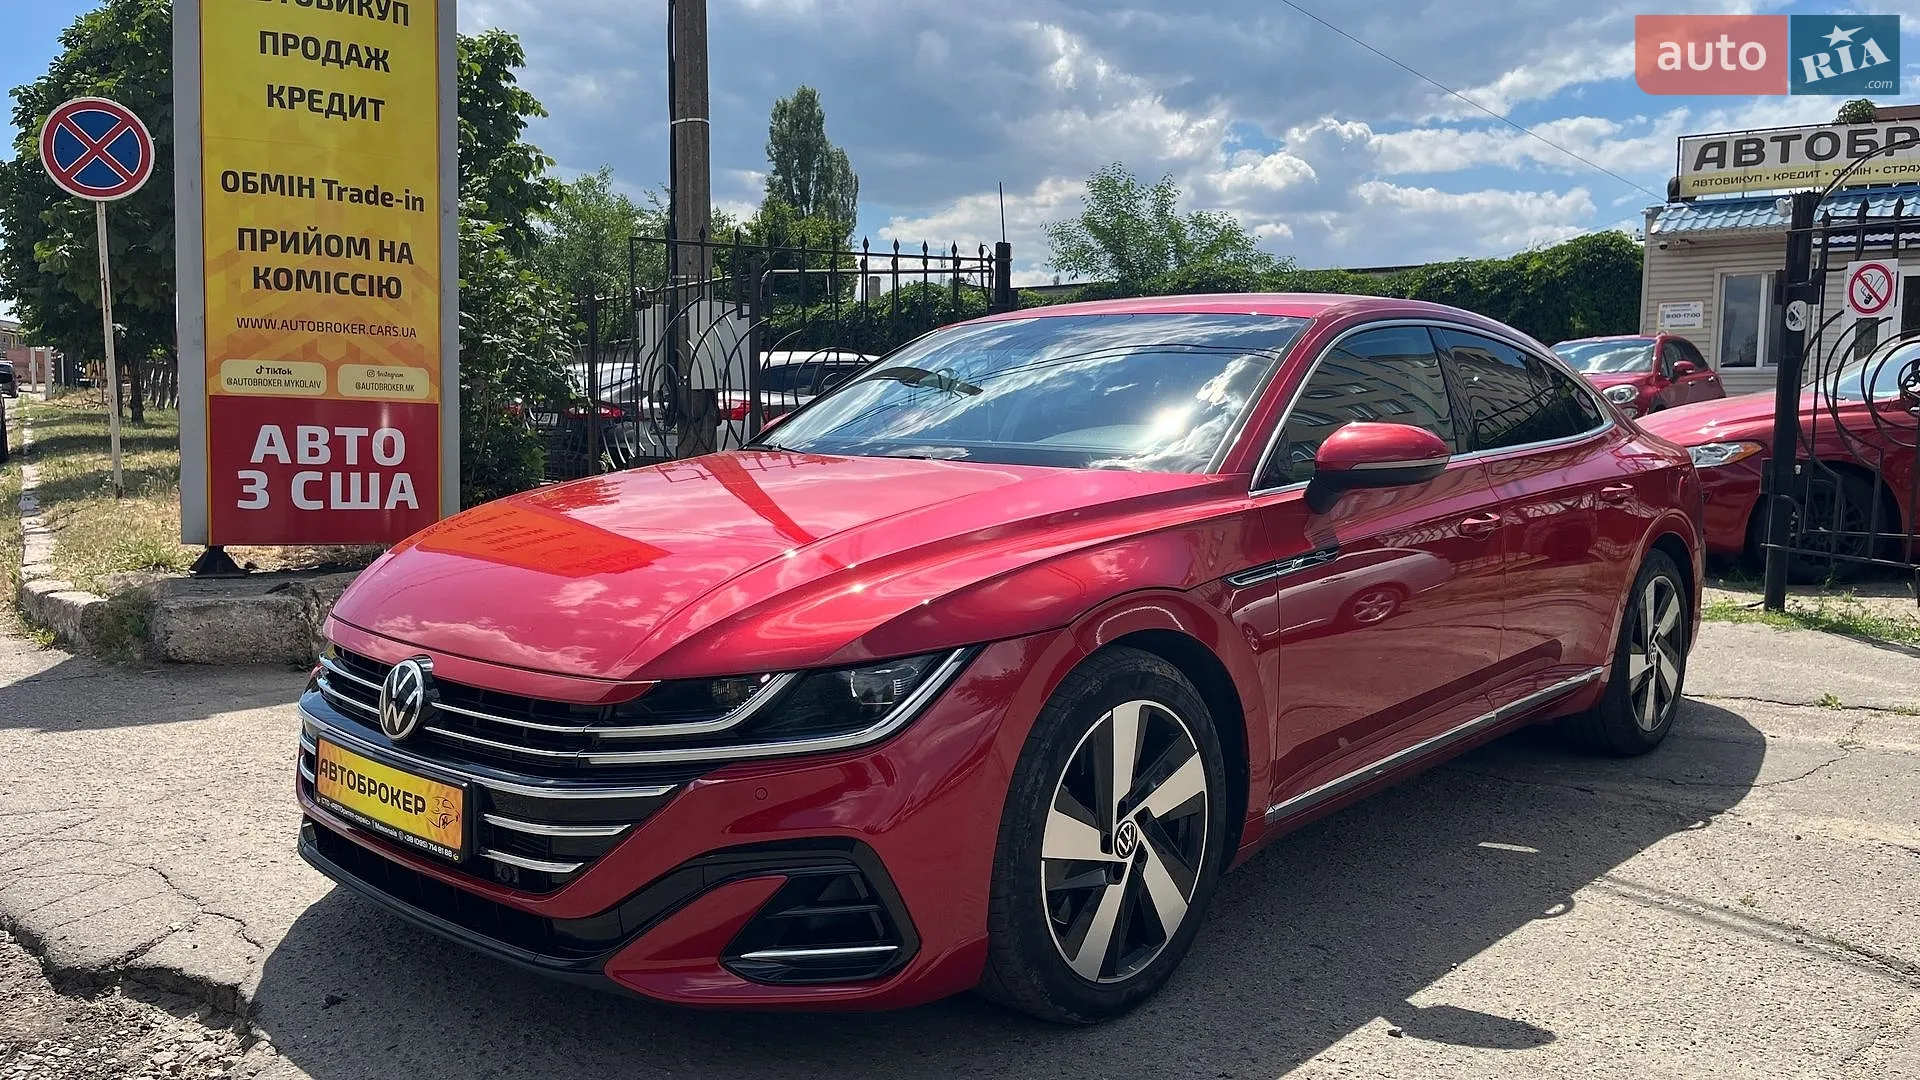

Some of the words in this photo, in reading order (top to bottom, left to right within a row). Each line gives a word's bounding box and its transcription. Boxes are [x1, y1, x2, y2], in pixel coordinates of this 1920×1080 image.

[260, 30, 391, 73] ПРОДАЖ
[267, 84, 385, 122] КРЕДИТ
[221, 170, 315, 198] ОБМІН
[322, 179, 425, 212] Trade-in
[1692, 174, 1762, 188] АВТОВИКУП
[1773, 169, 1821, 182] КРЕДИТ
[237, 225, 371, 261] ПРИЙОМ
[378, 240, 414, 265] НА
[253, 266, 402, 300] КОМІССІЮ
[236, 317, 418, 338] WWW.AUTOBROKER.CARS.UA
[250, 424, 406, 466] АВТО
[291, 470, 419, 511] США
[319, 758, 426, 816] АВТОБРОКЕР
